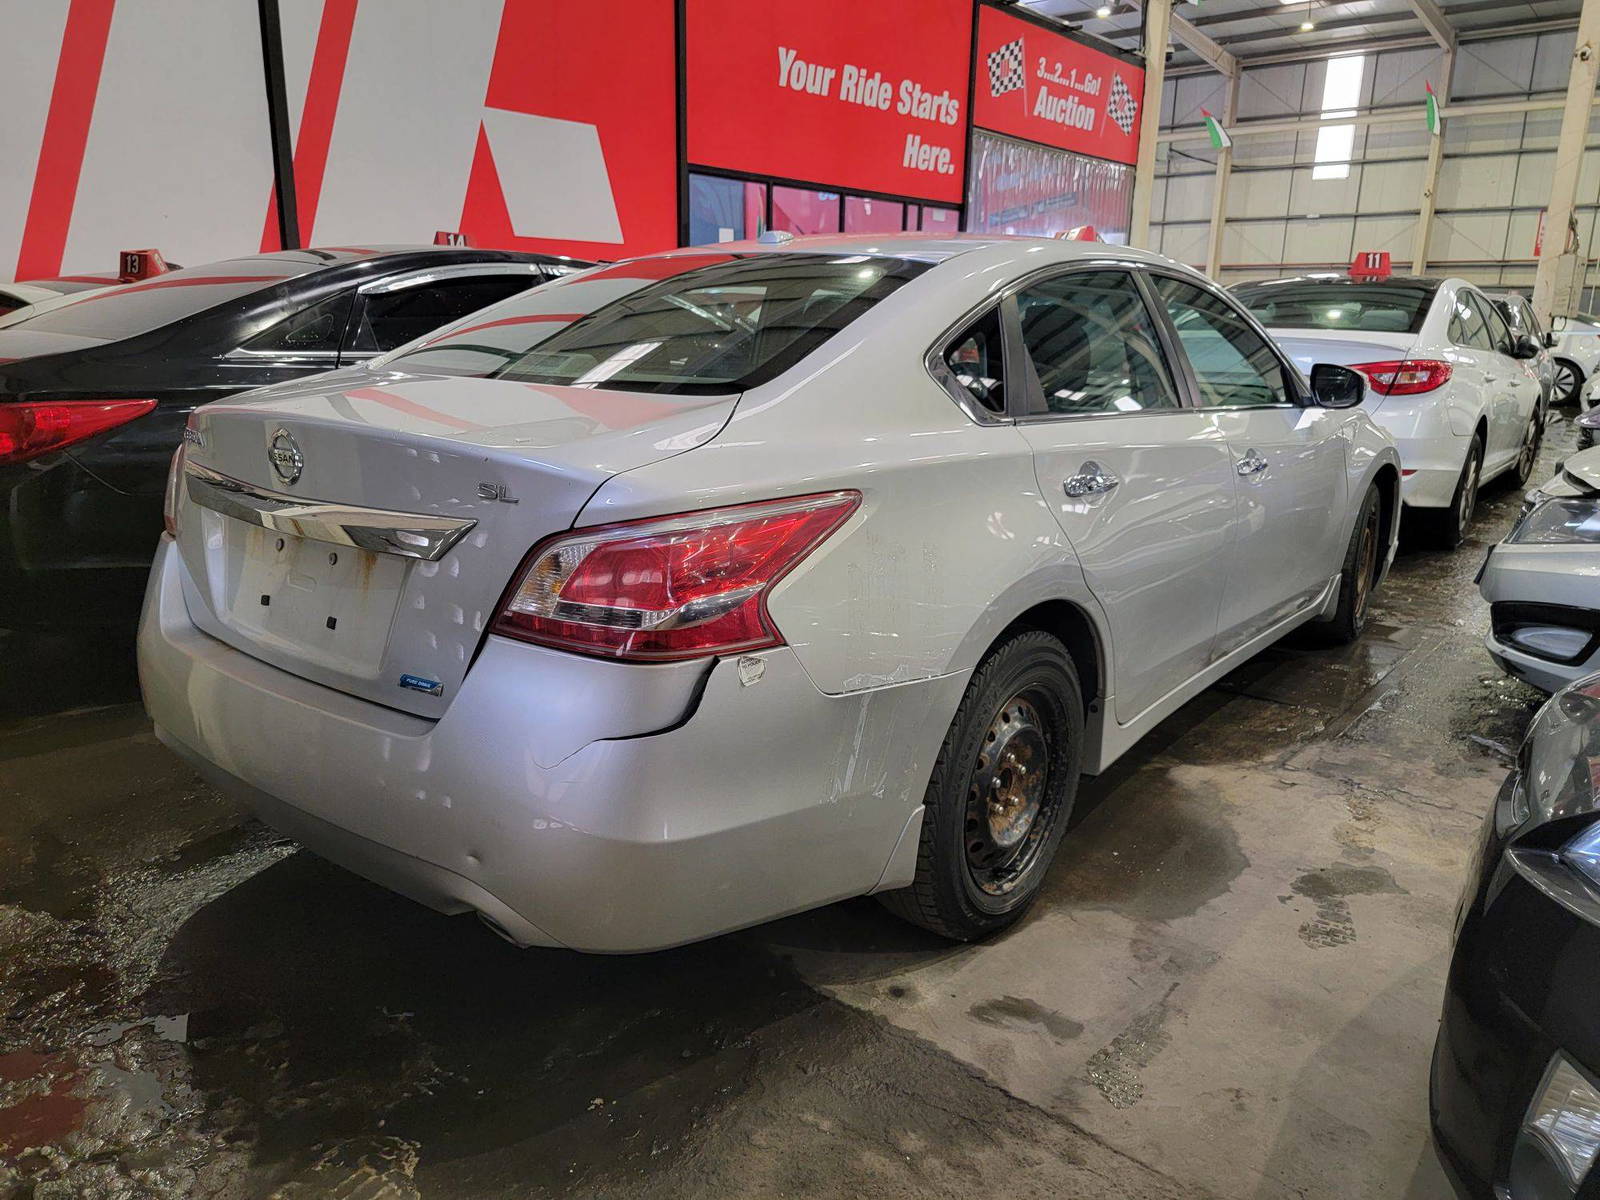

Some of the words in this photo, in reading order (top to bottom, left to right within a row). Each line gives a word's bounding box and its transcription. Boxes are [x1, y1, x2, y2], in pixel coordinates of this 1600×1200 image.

[778, 46, 836, 97] Your
[839, 63, 893, 111] Ride
[896, 79, 960, 126] Starts
[1033, 85, 1096, 131] Auction
[902, 133, 955, 175] Here.
[126, 254, 139, 273] 13
[1367, 253, 1381, 269] 11
[478, 483, 520, 504] SL
